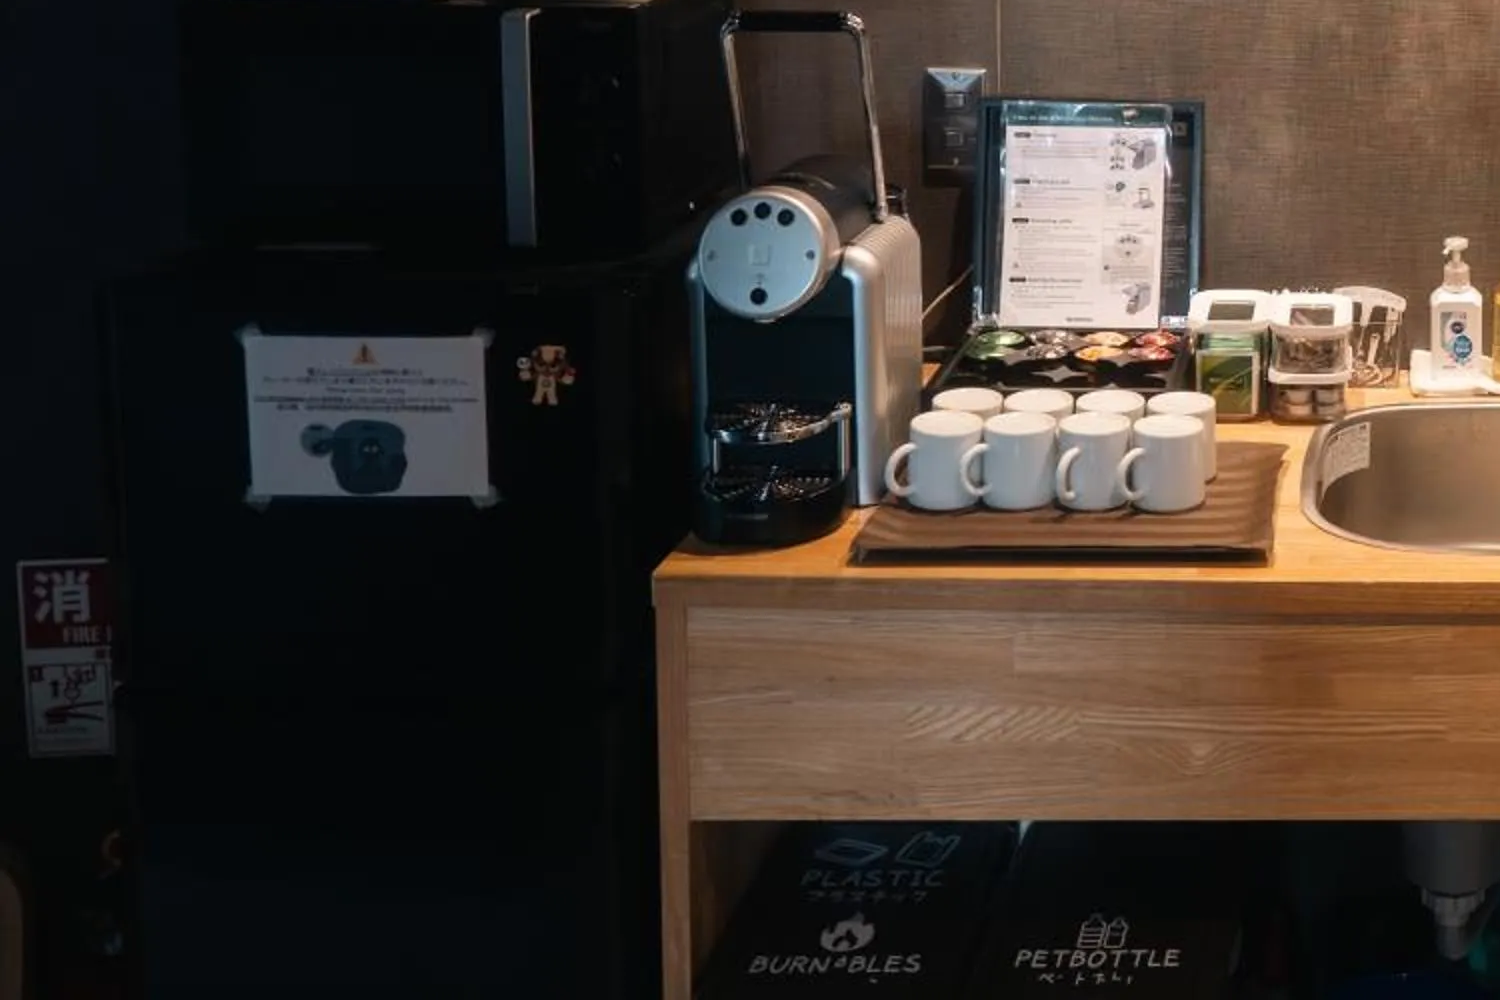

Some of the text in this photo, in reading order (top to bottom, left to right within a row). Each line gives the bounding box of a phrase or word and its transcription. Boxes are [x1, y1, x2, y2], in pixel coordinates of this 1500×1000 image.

[32, 569, 92, 624] 消
[62, 624, 102, 644] FIRE
[799, 869, 945, 887] PLASTIC
[1014, 948, 1182, 969] PETBOTTLE
